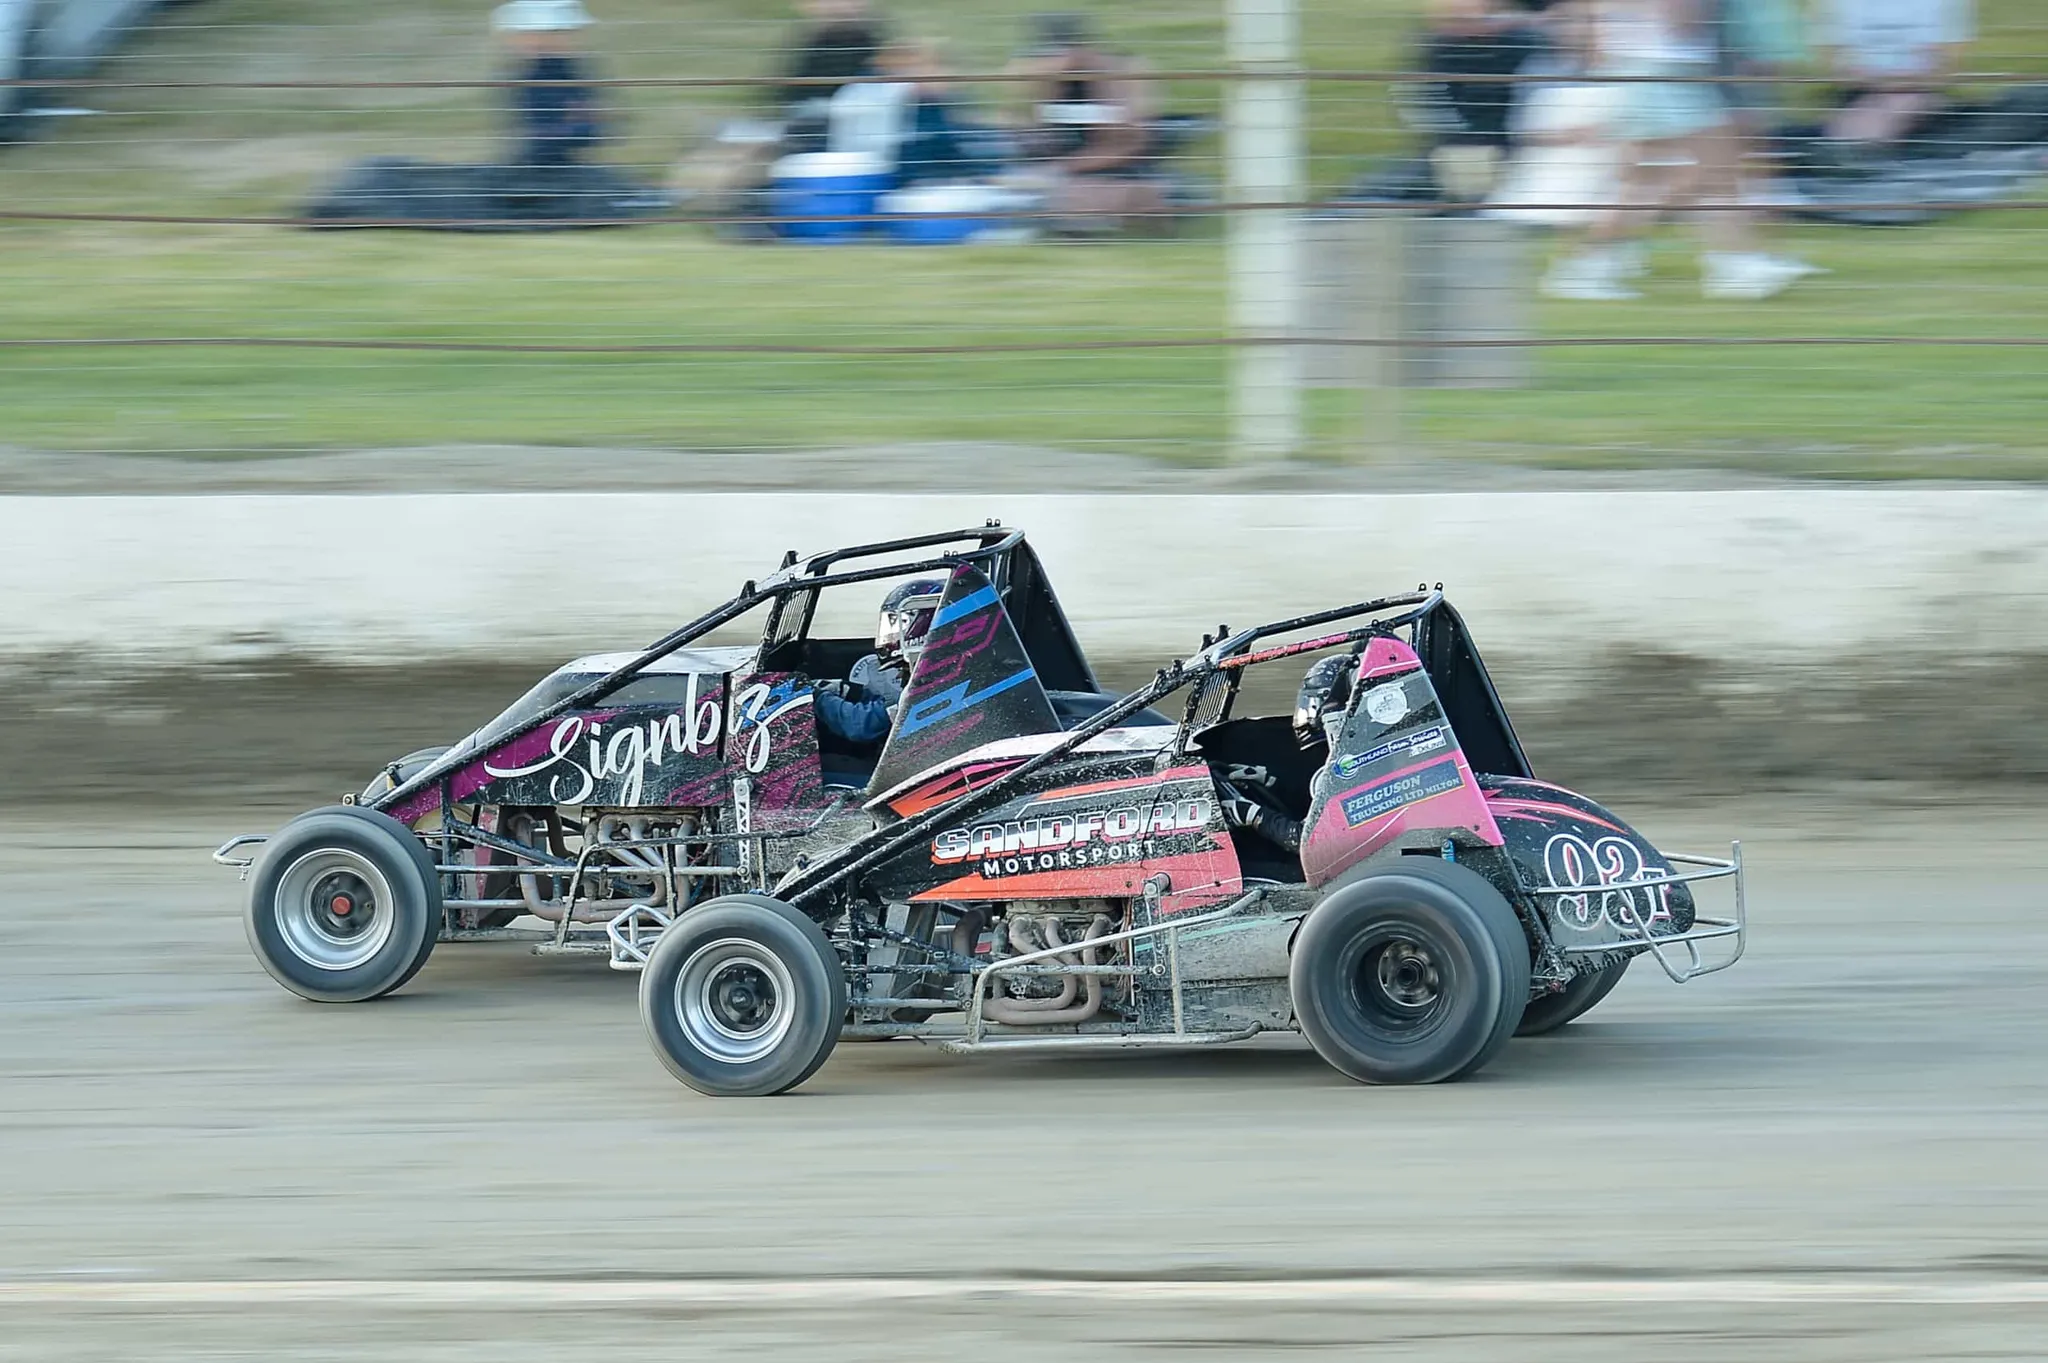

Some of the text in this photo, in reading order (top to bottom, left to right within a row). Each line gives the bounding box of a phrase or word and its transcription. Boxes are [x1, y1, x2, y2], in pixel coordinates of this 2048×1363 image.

[1346, 747, 1389, 770] SOUTHLAND
[1347, 774, 1420, 813] FERGUSON
[1350, 777, 1460, 821] TRUCKING LTD MILTON
[932, 798, 1212, 862] SANDFORD
[984, 839, 1156, 877] MOTORSPORT
